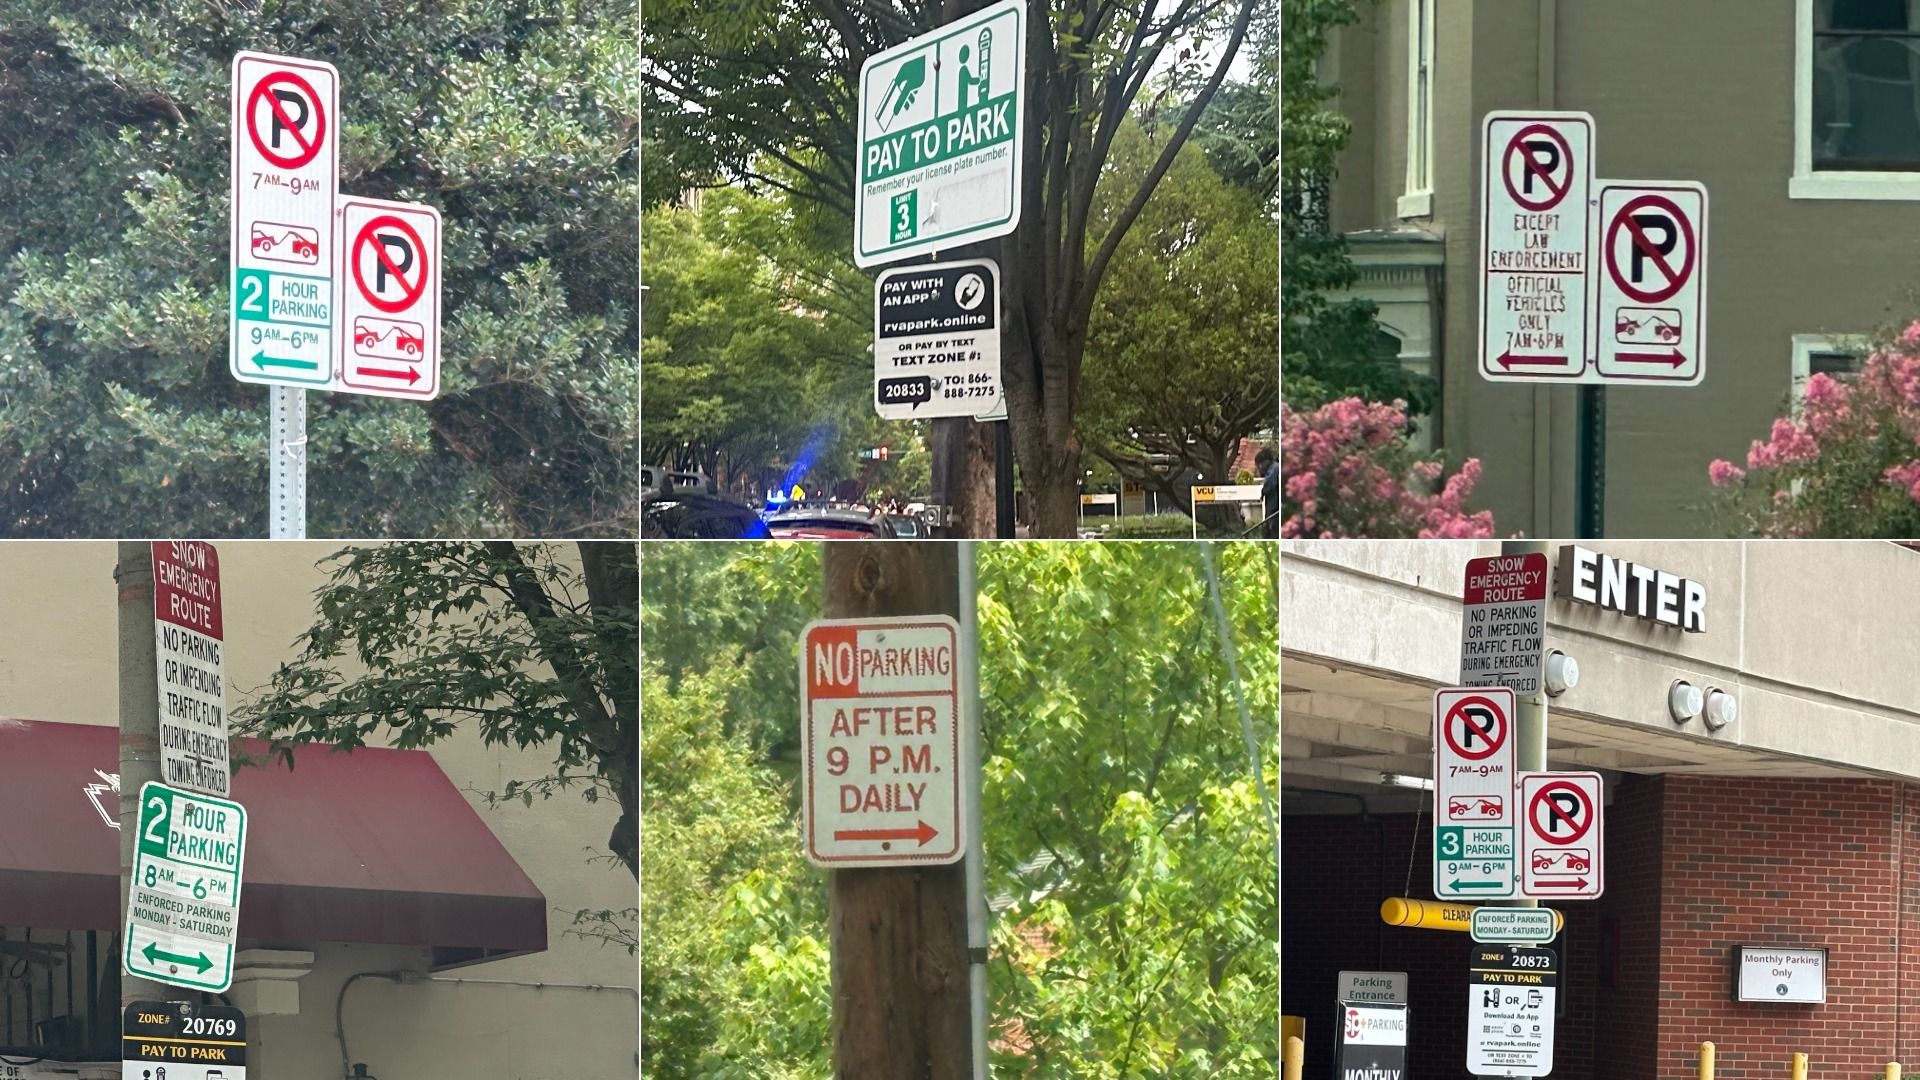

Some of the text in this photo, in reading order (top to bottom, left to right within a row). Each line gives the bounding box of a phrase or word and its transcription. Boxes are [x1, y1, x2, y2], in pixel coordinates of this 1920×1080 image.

[867, 99, 1010, 178] PAY TO PARK
[867, 146, 1008, 198] Remember your license plate number.
[895, 192, 911, 205] LIMIT
[897, 203, 910, 231] 3
[1514, 214, 1560, 231] EXCEPT
[894, 229, 912, 241] HOUR
[1524, 233, 1549, 249] LAW
[1491, 252, 1583, 269] ENFORCEMENT
[241, 275, 264, 312] 2
[282, 280, 319, 301] HOUR
[884, 277, 944, 293] PAY WITH
[1507, 277, 1563, 293] OFFICIAL
[883, 293, 929, 307] AN APP
[1506, 295, 1566, 313] VEHICLES
[272, 298, 328, 320] PARKING
[884, 314, 986, 333] rvapark.online
[1518, 314, 1550, 330] ONLY
[898, 337, 975, 351] OR PAY BY TEXT
[892, 351, 981, 367] TEXT ZONE #:
[944, 373, 992, 385] TO: 866-
[885, 382, 925, 398] 20833
[944, 385, 995, 399] 888-7275
[1196, 487, 1214, 495] VCU
[171, 540, 205, 571] SNOW
[1488, 557, 1525, 573] SNOW
[159, 560, 217, 603] EMERGENCY
[1470, 570, 1542, 589] EMERGENCY
[1483, 586, 1526, 603] ROUTE
[1573, 545, 1707, 633] ENTER
[171, 592, 212, 629] ROUTE
[1471, 605, 1537, 623] NO PARKING
[1468, 621, 1538, 639] OR IMPEDING
[163, 626, 220, 666] NO PARKING
[1464, 637, 1542, 655] TRAFFIC FLOW
[814, 641, 950, 687] NO PARKING
[1463, 654, 1541, 672] DURING EMERGENCY
[165, 658, 221, 698] OR IMPENDING
[1497, 678, 1536, 691] ENFORCED
[167, 692, 222, 729] TRAFFIC FLOW
[829, 705, 937, 738] AFTER
[163, 723, 227, 763] DURING EMERGENCY
[826, 743, 941, 777] 9 P.M.
[167, 757, 226, 794] TOWING ENFORCED
[840, 782, 927, 814] DAILY
[144, 796, 167, 844] 2
[183, 805, 226, 834] HOUR
[1442, 831, 1459, 855] 3
[1473, 832, 1503, 843] HOUR
[169, 830, 235, 866] PARKING
[1465, 844, 1510, 855] PARKING
[138, 892, 231, 922] ENFORCED PARKING
[1443, 908, 1471, 922] CLEARA
[134, 906, 171, 926] MONDAY
[179, 918, 233, 937] SATURDAY
[1478, 914, 1548, 924] ENFORCED PARKING
[1477, 926, 1507, 934] MONDAY
[1512, 927, 1549, 935] SATURDAY
[1481, 953, 1550, 968] ZONE# 20873
[1745, 954, 1820, 967] Monthly Parking
[1483, 973, 1542, 983] PAY TO PARK
[1772, 968, 1793, 979] Only
[1353, 977, 1392, 990] Parking
[1350, 990, 1395, 1000] Entrance
[1505, 996, 1519, 1005] OR
[138, 1013, 237, 1037] ZONE# 20769
[1368, 1018, 1404, 1031] PARKING
[1526, 1013, 1539, 1021] App
[141, 1044, 226, 1060] PAY TO PARK
[1486, 1040, 1541, 1048] rvapark.online
[1345, 1069, 1400, 1080] MONTHLY
